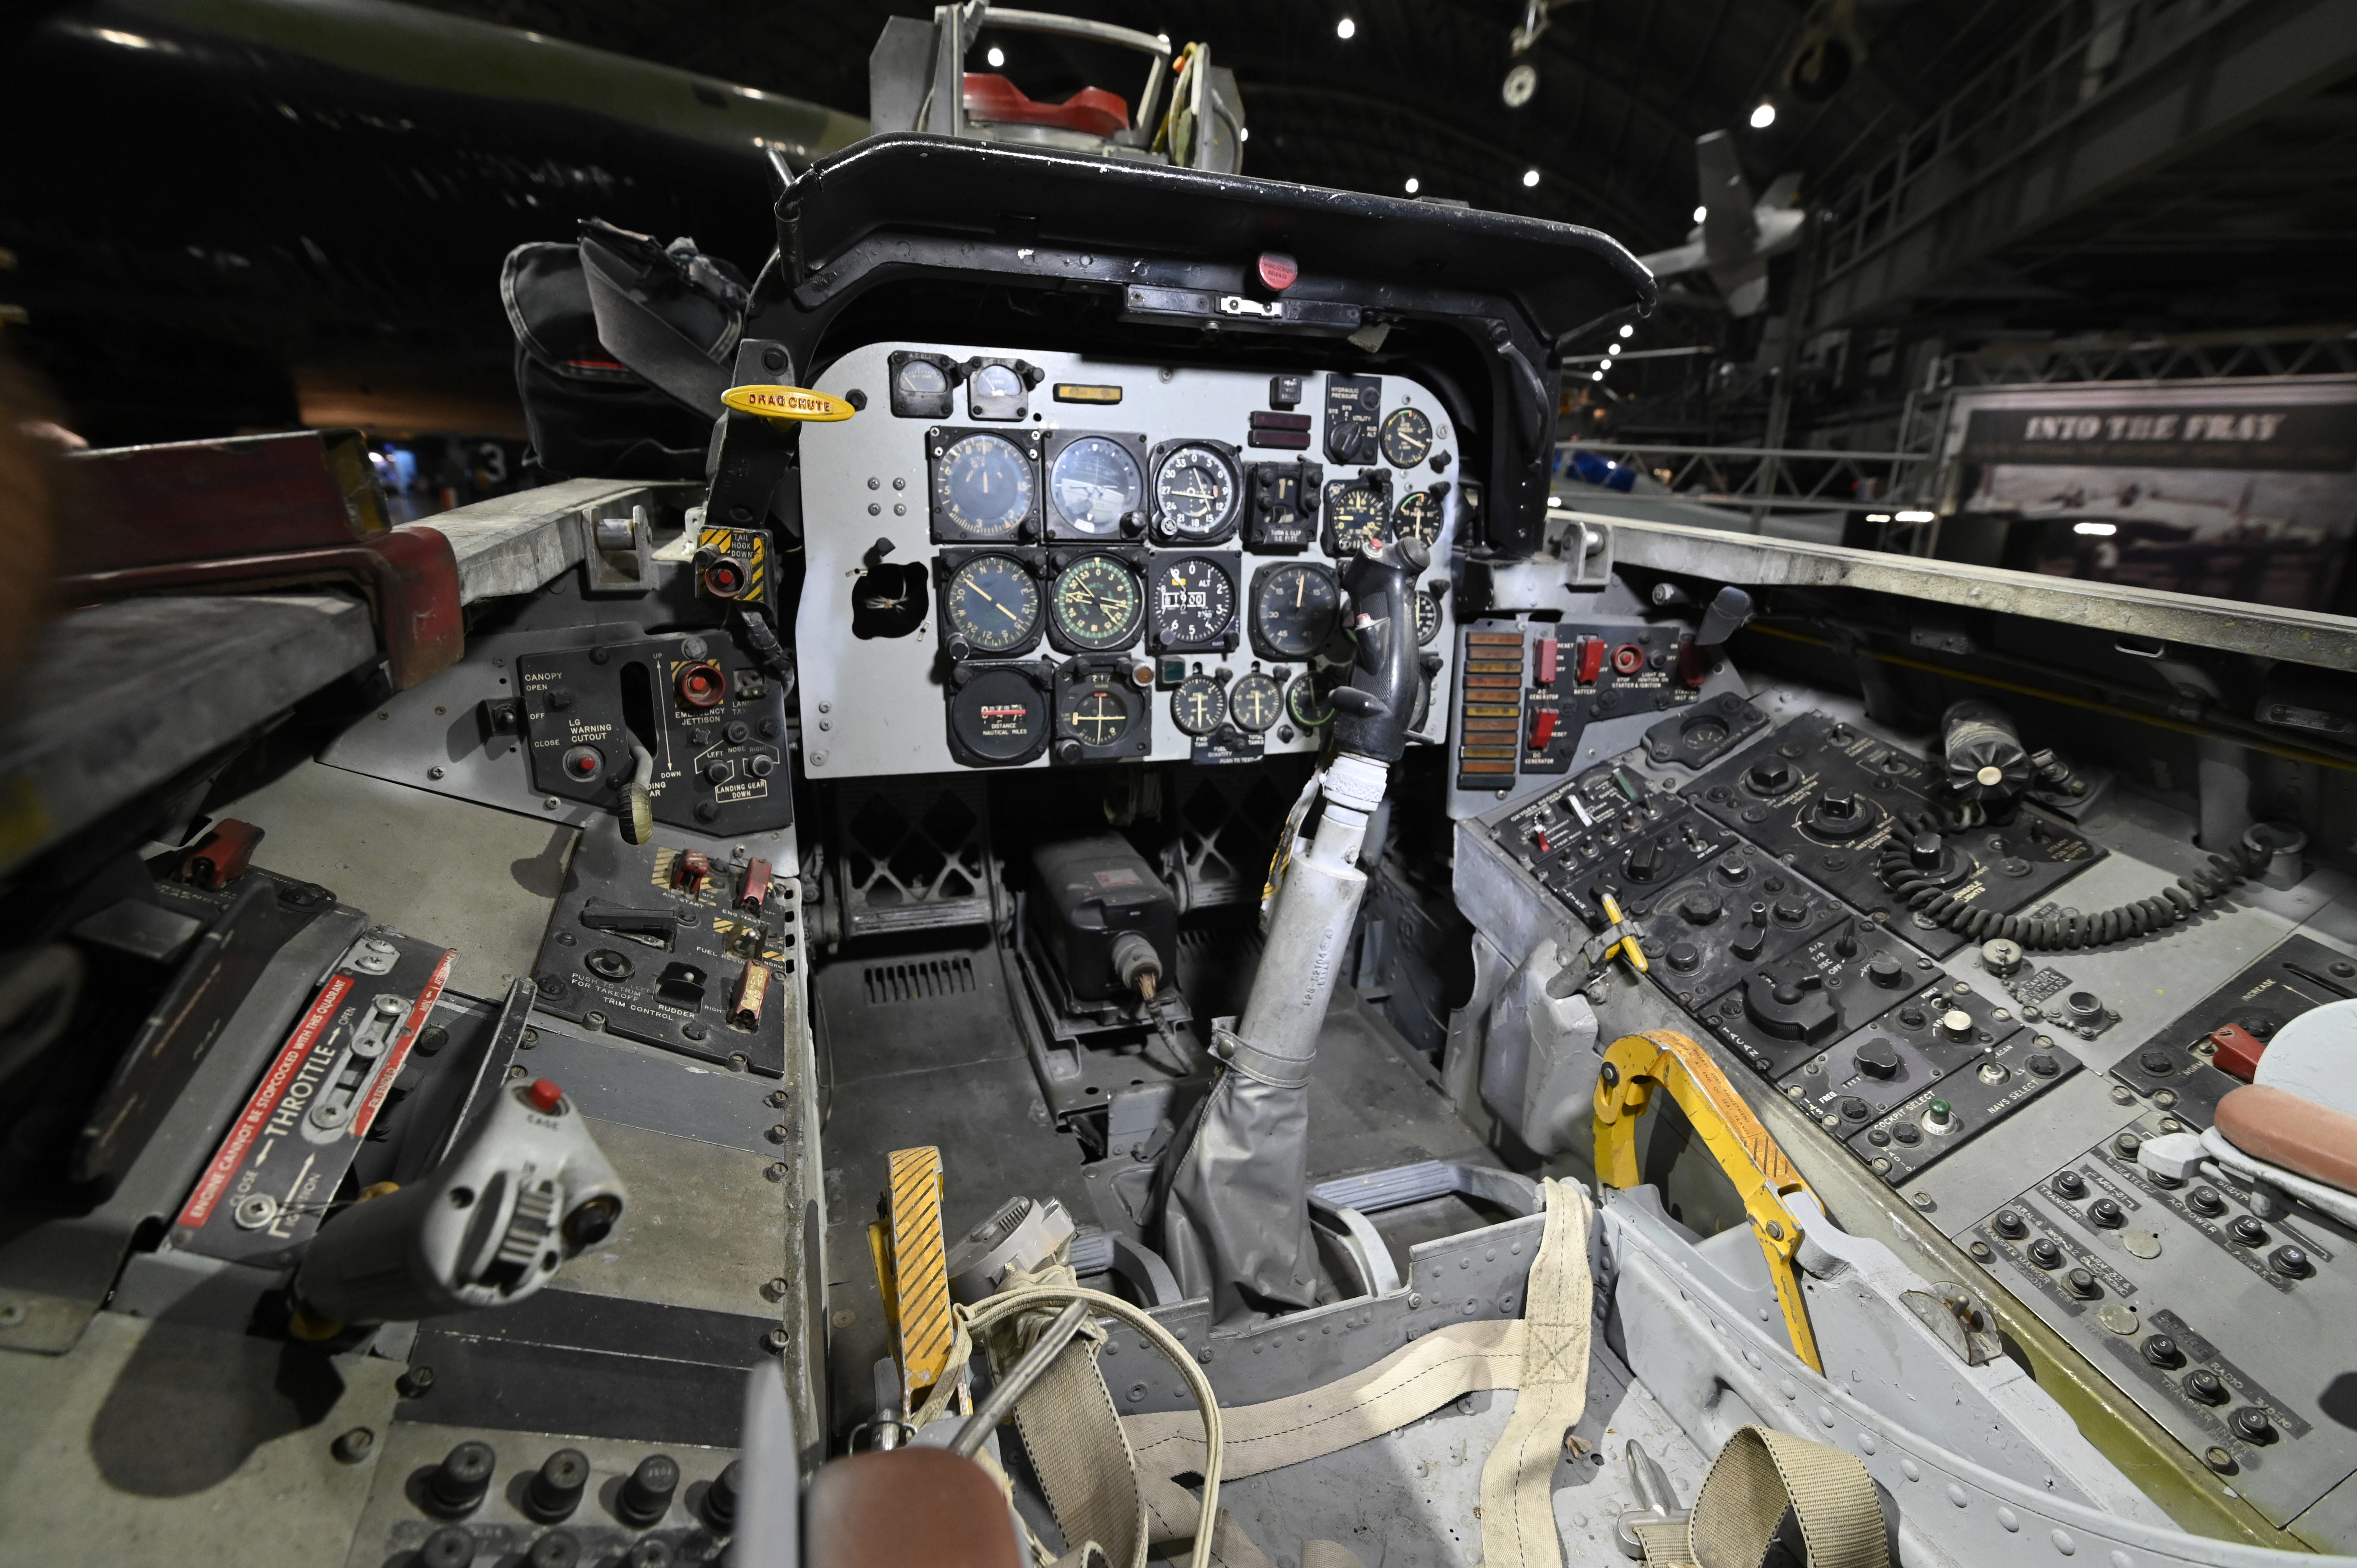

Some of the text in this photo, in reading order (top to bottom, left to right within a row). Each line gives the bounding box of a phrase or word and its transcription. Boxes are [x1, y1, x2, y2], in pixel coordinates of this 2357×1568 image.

[1268, 270, 1287, 279] RELEASE
[749, 394, 830, 412] DRAG CHUTE
[2026, 412, 2287, 441] INTO THE FRAY
[1176, 459, 1186, 467] 33
[1166, 470, 1176, 478] 30
[1161, 486, 1171, 494] 27
[1166, 502, 1177, 510] 24
[1191, 519, 1199, 527] 18
[1206, 515, 1214, 523] 15
[1189, 625, 1195, 634] 5
[525, 672, 562, 682] CANOPY
[675, 708, 725, 719] EMERGENCY
[682, 716, 721, 726] JETTISON
[570, 724, 612, 733] WARNING
[571, 733, 606, 743] CUTOUT
[717, 781, 765, 794] LANDING GEAR
[731, 789, 751, 798] DOWN
[1511, 804, 1537, 821] OXYGEN
[1854, 826, 1893, 851] INSTRUMENT
[1868, 834, 1892, 849] LIGHTS
[663, 892, 705, 909] AIR START
[696, 946, 717, 957] FUEL
[1808, 941, 1825, 954] A/A
[764, 961, 783, 969] NORM
[1811, 952, 1827, 962] T/R
[1817, 958, 1833, 970] REC
[1828, 963, 1843, 975] OFF
[572, 973, 642, 997] PUSH TO TRIM
[631, 984, 650, 993] LEFT
[2026, 971, 2051, 989] CAMERA
[571, 979, 639, 1002] FOR TAKEOFF
[1921, 987, 1939, 999] POWER
[2242, 978, 2277, 1001] INCREASE
[338, 1006, 356, 1026] OPEN
[603, 996, 673, 1021] TRIM CONTROL
[658, 1004, 695, 1019] RUDDER
[705, 1005, 726, 1014] RIGHT
[1722, 1026, 1759, 1057] TACAN
[2014, 1068, 2025, 1077] ILS
[2182, 1061, 2204, 1076] NORM
[264, 1044, 336, 1138] THROTTLE
[1693, 1049, 1709, 1068] RELEASE
[1711, 1072, 1721, 1084] SEAT
[1723, 1088, 1750, 1123] ADJUSTMENT
[190, 980, 347, 1219] ENGINE CANNOT BE STOPCOCKED WITH THIS QUADRANT
[1702, 1072, 1712, 1082] END
[1721, 1098, 1733, 1111] SEAT
[1734, 1115, 1751, 1135] TRAVEL
[1819, 1091, 1838, 1104] FREQ
[1987, 1079, 2041, 1114] NAVS SELECT
[1874, 1090, 1936, 1131] COCKPIT SELECT
[1882, 1146, 1914, 1172] RADIO
[2111, 1161, 2150, 1192] HEATER
[229, 1169, 259, 1207] CLOSE
[2217, 1180, 2249, 1201] SIGHT
[287, 1172, 322, 1227] IGNITION
[2040, 1186, 2081, 1219] TRANSFER
[2167, 1199, 2217, 1234] AC POWER
[2244, 1219, 2255, 1228] 15
[1980, 1225, 2018, 1257] TRANSFER
[2287, 1250, 2299, 1258] 10
[2017, 1256, 2051, 1284] MARKER
[2055, 1286, 2078, 1305] TEST
[2158, 1314, 2209, 1357] SPARE
[2210, 1362, 2244, 1389] RADIO
[2161, 1377, 2213, 1423] TRANSFER
[2216, 1427, 2249, 1454] INTER
